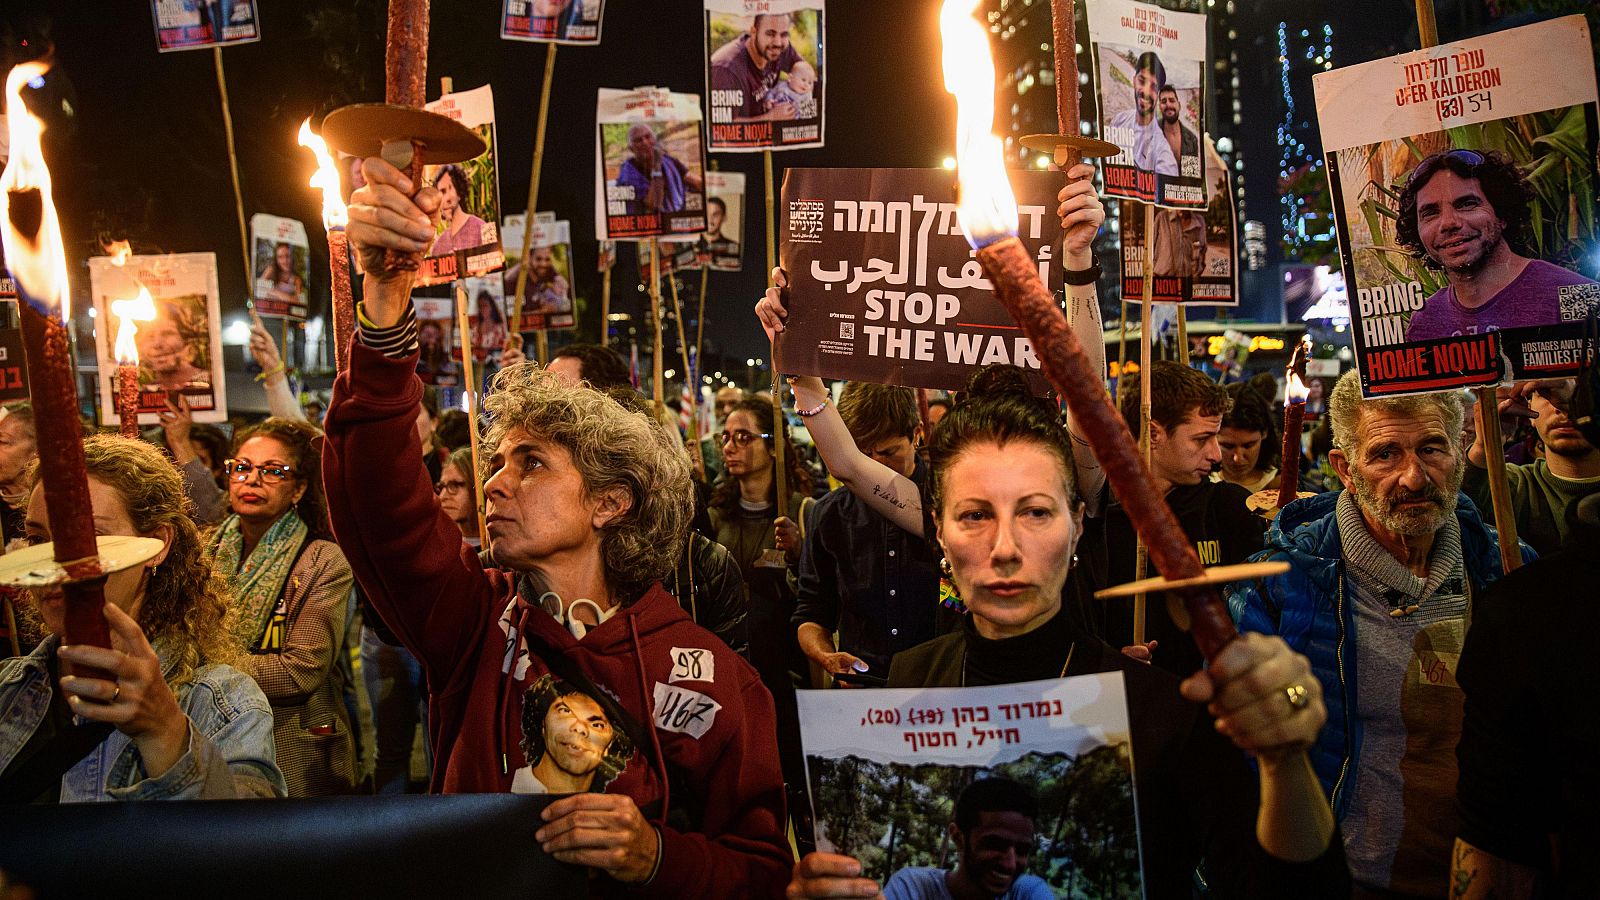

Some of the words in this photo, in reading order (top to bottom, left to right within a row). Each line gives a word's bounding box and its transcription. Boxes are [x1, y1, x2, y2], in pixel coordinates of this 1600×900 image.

[1404, 57, 1448, 85] קלדרון
[1451, 49, 1485, 72] עופר
[1395, 84, 1428, 106] OFER
[1430, 68, 1501, 100] KALDERON
[711, 90, 743, 107] BRING
[1467, 91, 1492, 112] 54
[712, 106, 733, 123] HIM
[712, 124, 742, 141] HOME
[744, 120, 773, 140] NOW!
[1104, 126, 1135, 146] BRING
[1105, 167, 1136, 188] HOME
[790, 199, 824, 210] מסתכלים
[790, 210, 824, 220] לכיבוש
[608, 215, 635, 231] HOME
[790, 220, 823, 234] בעיניים
[1155, 277, 1182, 296] NOW!
[864, 289, 961, 326] STOP
[1357, 280, 1424, 318] BRING
[1362, 315, 1405, 348] HIM
[863, 325, 936, 362] THE
[943, 331, 1042, 370] WAR
[1521, 340, 1559, 353] HOSTAGES
[1560, 339, 1576, 350] AND
[1367, 347, 1430, 381] HOME
[1431, 334, 1497, 375] NOW!
[1523, 349, 1571, 367] FAMILIES
[676, 650, 704, 679] 98
[1421, 656, 1448, 683] 467
[659, 691, 714, 729] 467
[952, 705, 989, 728] כהן
[998, 699, 1063, 721] נמרוד
[903, 730, 957, 752] חטוף
[966, 726, 1021, 749] חייל,
